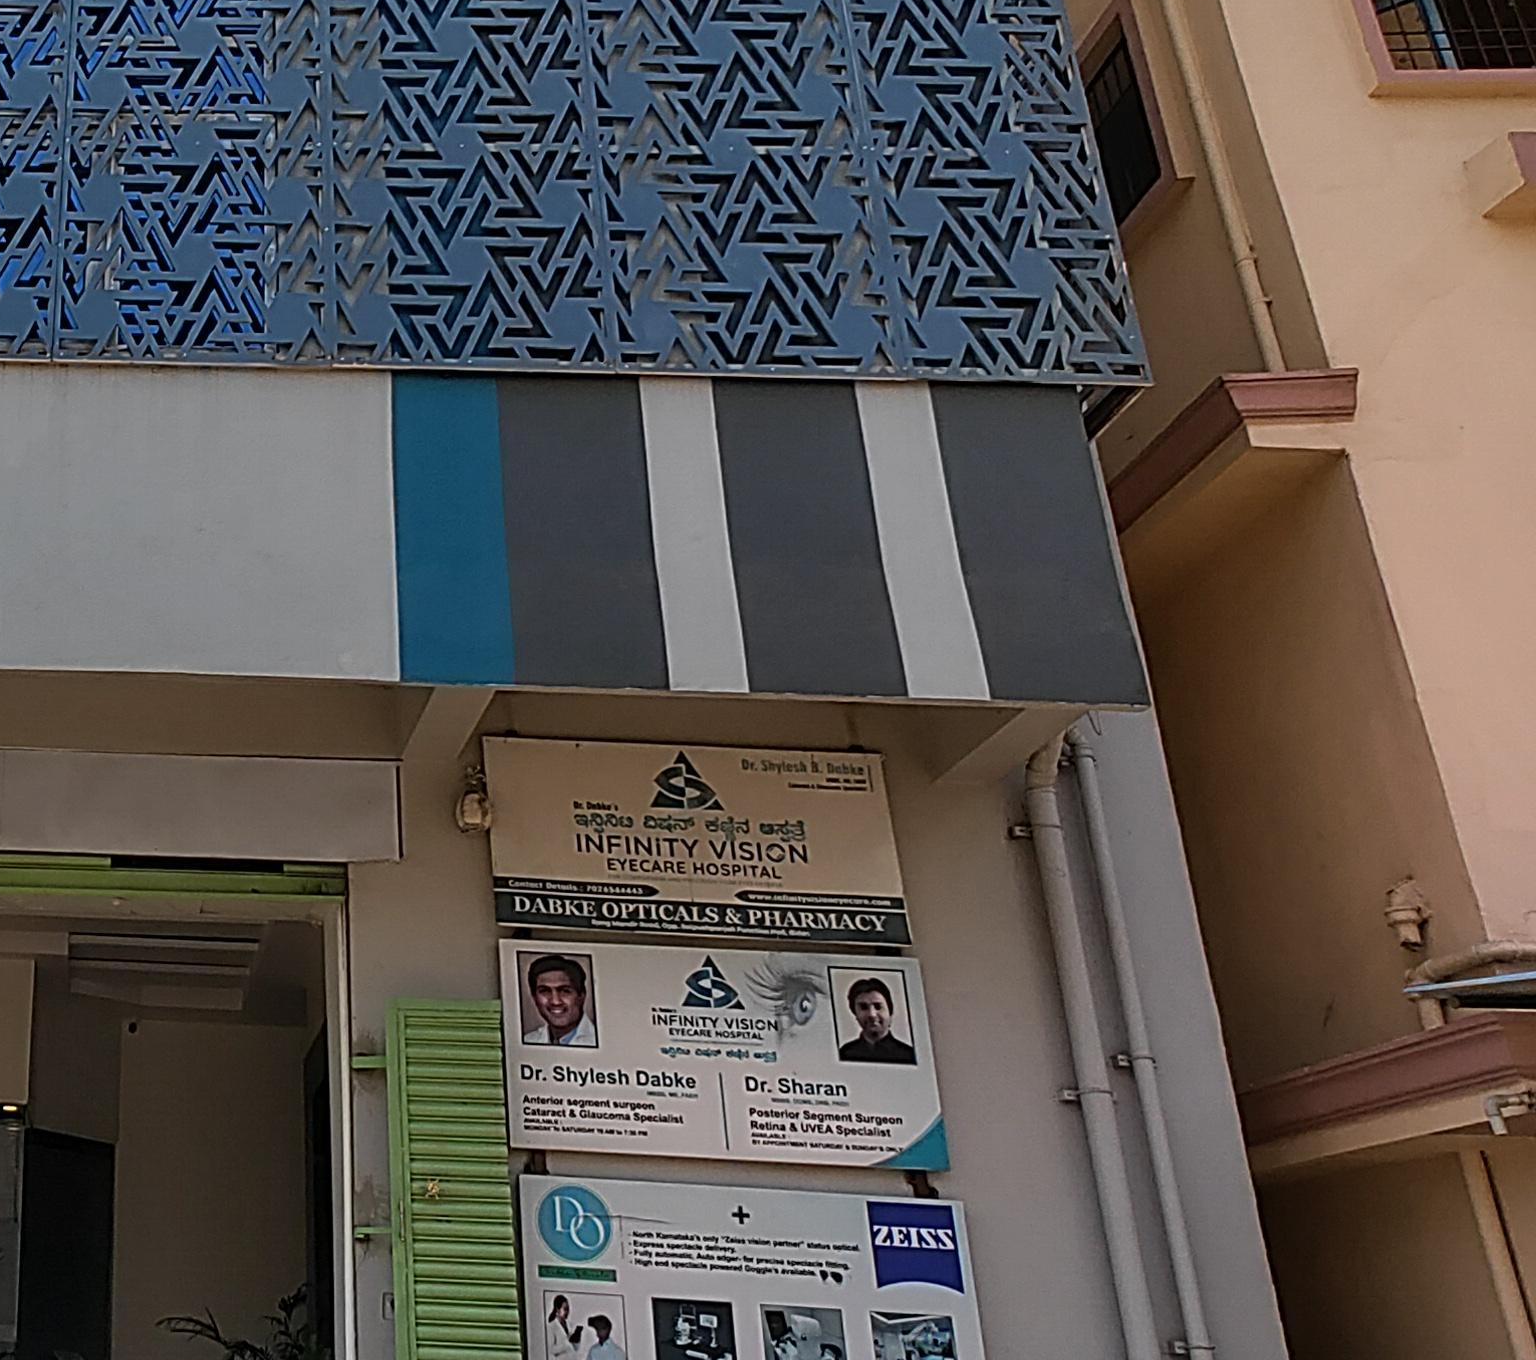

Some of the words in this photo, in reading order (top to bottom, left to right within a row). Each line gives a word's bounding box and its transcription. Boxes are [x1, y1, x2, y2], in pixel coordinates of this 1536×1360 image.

[741, 759, 758, 771] Dr.
[761, 760, 807, 775] Shylesh
[827, 763, 864, 776] Dabke
[709, 840, 808, 864] VISION
[607, 858, 686, 875] EYECARE
[693, 861, 782, 880] HOSPITAL
[514, 895, 597, 918] DABKE
[602, 901, 719, 923] OPTICALS
[725, 907, 743, 924] &
[747, 909, 887, 932] PHARMACY
[724, 1017, 778, 1031] VISION
[669, 1028, 712, 1038] EYECARE
[715, 1030, 764, 1040] HOSPITAL
[520, 1064, 547, 1081] Dr.
[552, 1066, 629, 1086] Shylesh
[636, 1070, 696, 1089] Dabke
[745, 1076, 772, 1093] Dr.
[777, 1078, 848, 1097] Sharan
[523, 1095, 564, 1106] Anterior
[566, 1098, 610, 1111] segment
[613, 1101, 655, 1112] surgeon
[523, 1107, 566, 1118] Cataract
[569, 1108, 576, 1118] &
[579, 1109, 631, 1121] Glaucoma
[633, 1113, 684, 1126] Specialist
[749, 1107, 800, 1120] Posterior
[803, 1110, 852, 1124] Segment
[855, 1113, 903, 1126] Surgeon
[750, 1121, 786, 1131] Retina
[789, 1122, 798, 1132] &
[801, 1123, 833, 1134] UVEA
[836, 1126, 891, 1138] Specialist
[633, 1240, 664, 1248] Express
[873, 1225, 955, 1250] ZEISS
[634, 1248, 652, 1258] Fully
[696, 1252, 715, 1260] Auto
[634, 1258, 653, 1267] High
